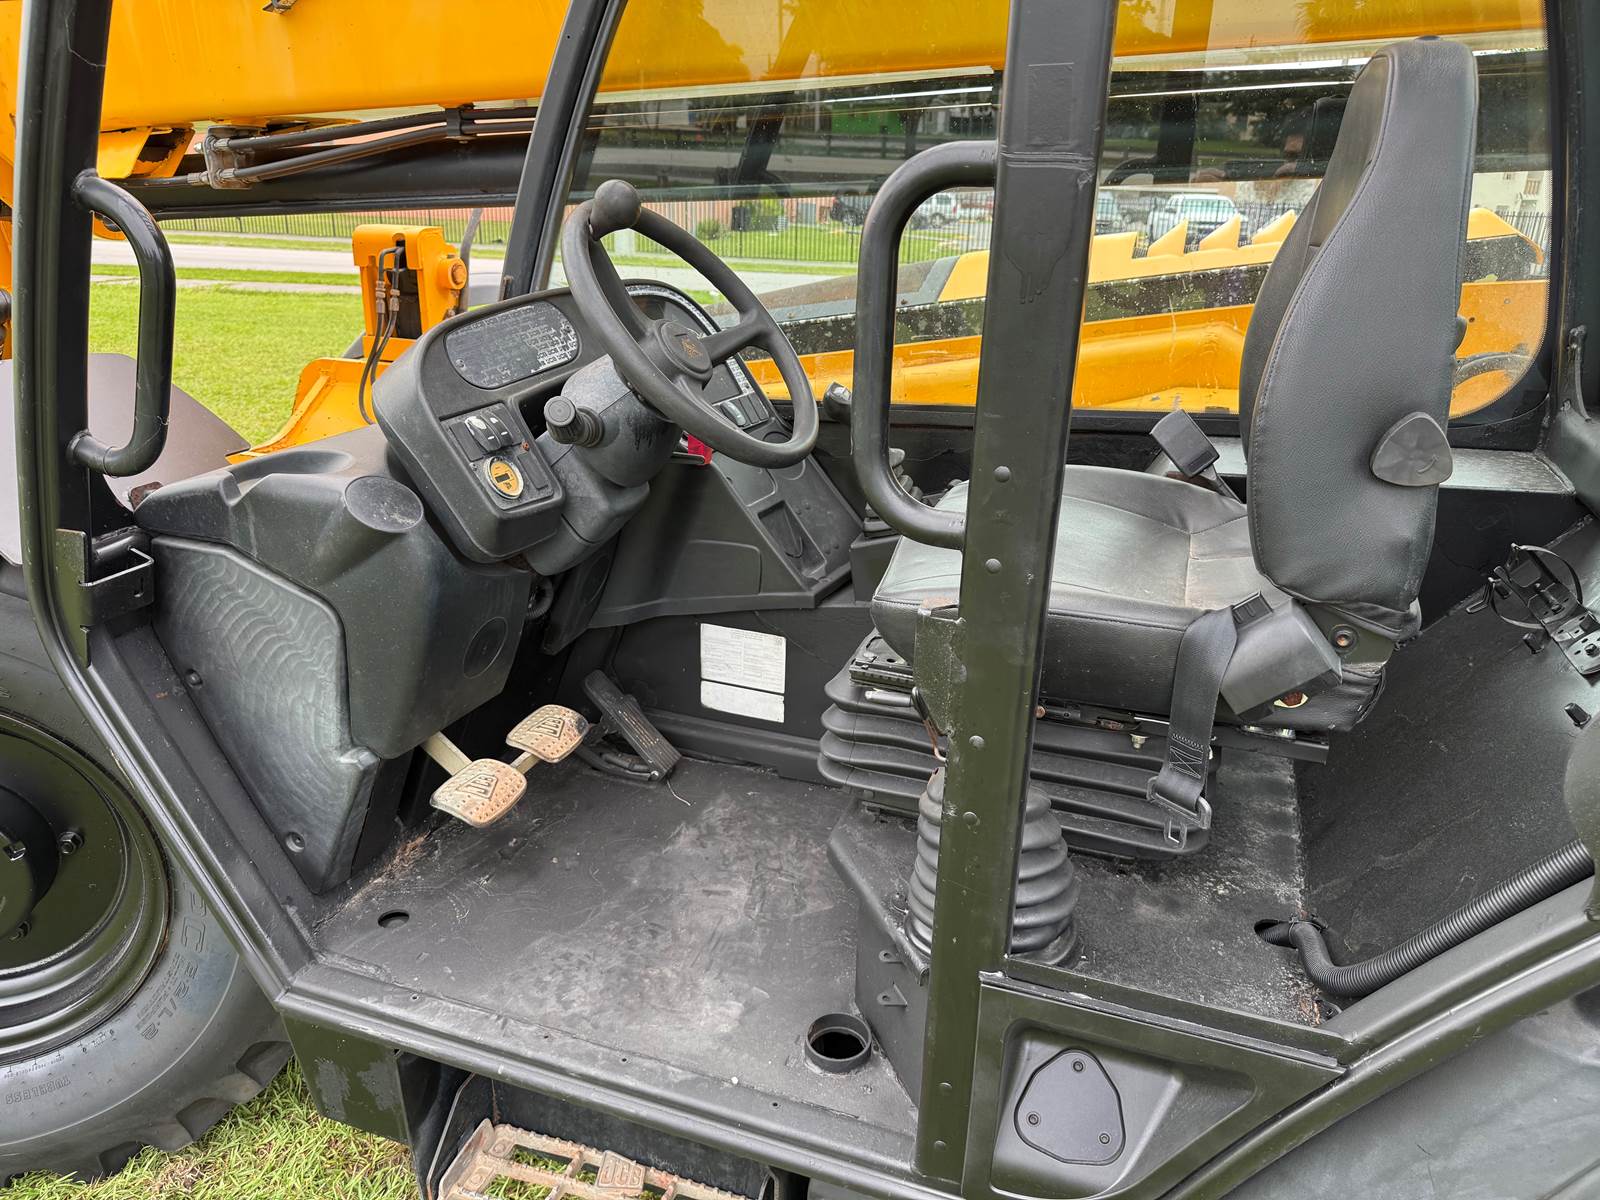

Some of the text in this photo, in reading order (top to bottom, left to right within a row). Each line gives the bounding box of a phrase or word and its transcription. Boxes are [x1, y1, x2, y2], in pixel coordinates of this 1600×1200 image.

[534, 718, 562, 736] JCB
[463, 775, 494, 796] JCB
[600, 1157, 643, 1187] JCB
